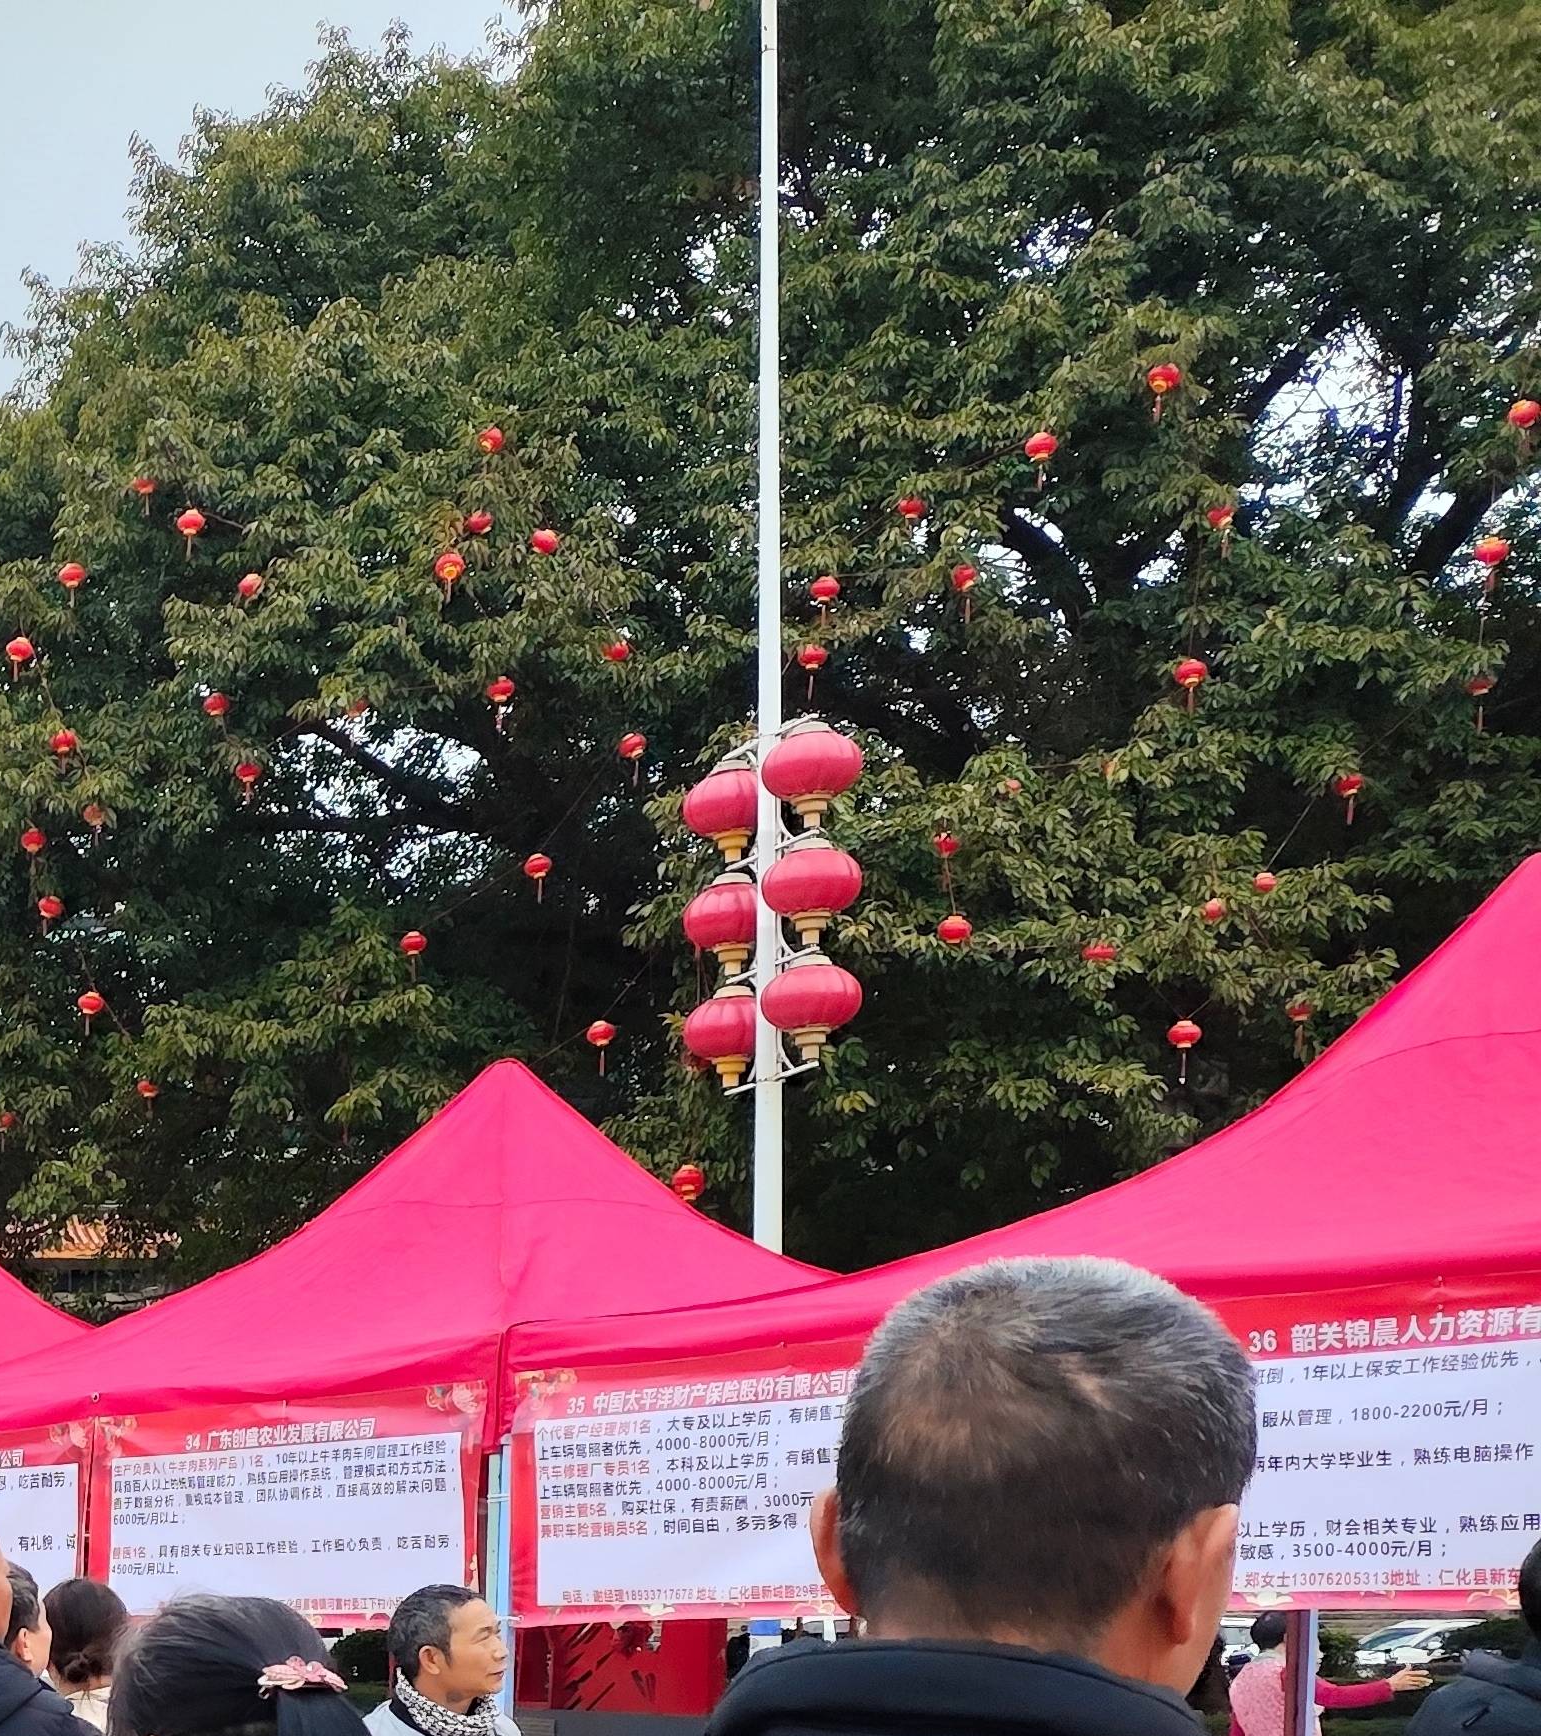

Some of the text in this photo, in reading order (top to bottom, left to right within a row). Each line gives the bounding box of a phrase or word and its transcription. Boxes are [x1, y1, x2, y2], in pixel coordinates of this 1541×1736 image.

[1248, 1304, 1541, 1353] 36 韶关锦晨人力资源有
[1256, 1349, 1541, 1386] 班倒，1年以上保安工作经验优先，
[566, 1397, 586, 1415] 35
[1262, 1398, 1504, 1428] 服从管理，1800-2200元/月；
[185, 1417, 377, 1451] 34 广东创盛农业发展有限公司
[1237, 1512, 1541, 1539] 以上学历，财会相关专业，熟练应用
[1236, 1539, 1448, 1561] 敏感，3500-4000元/月；
